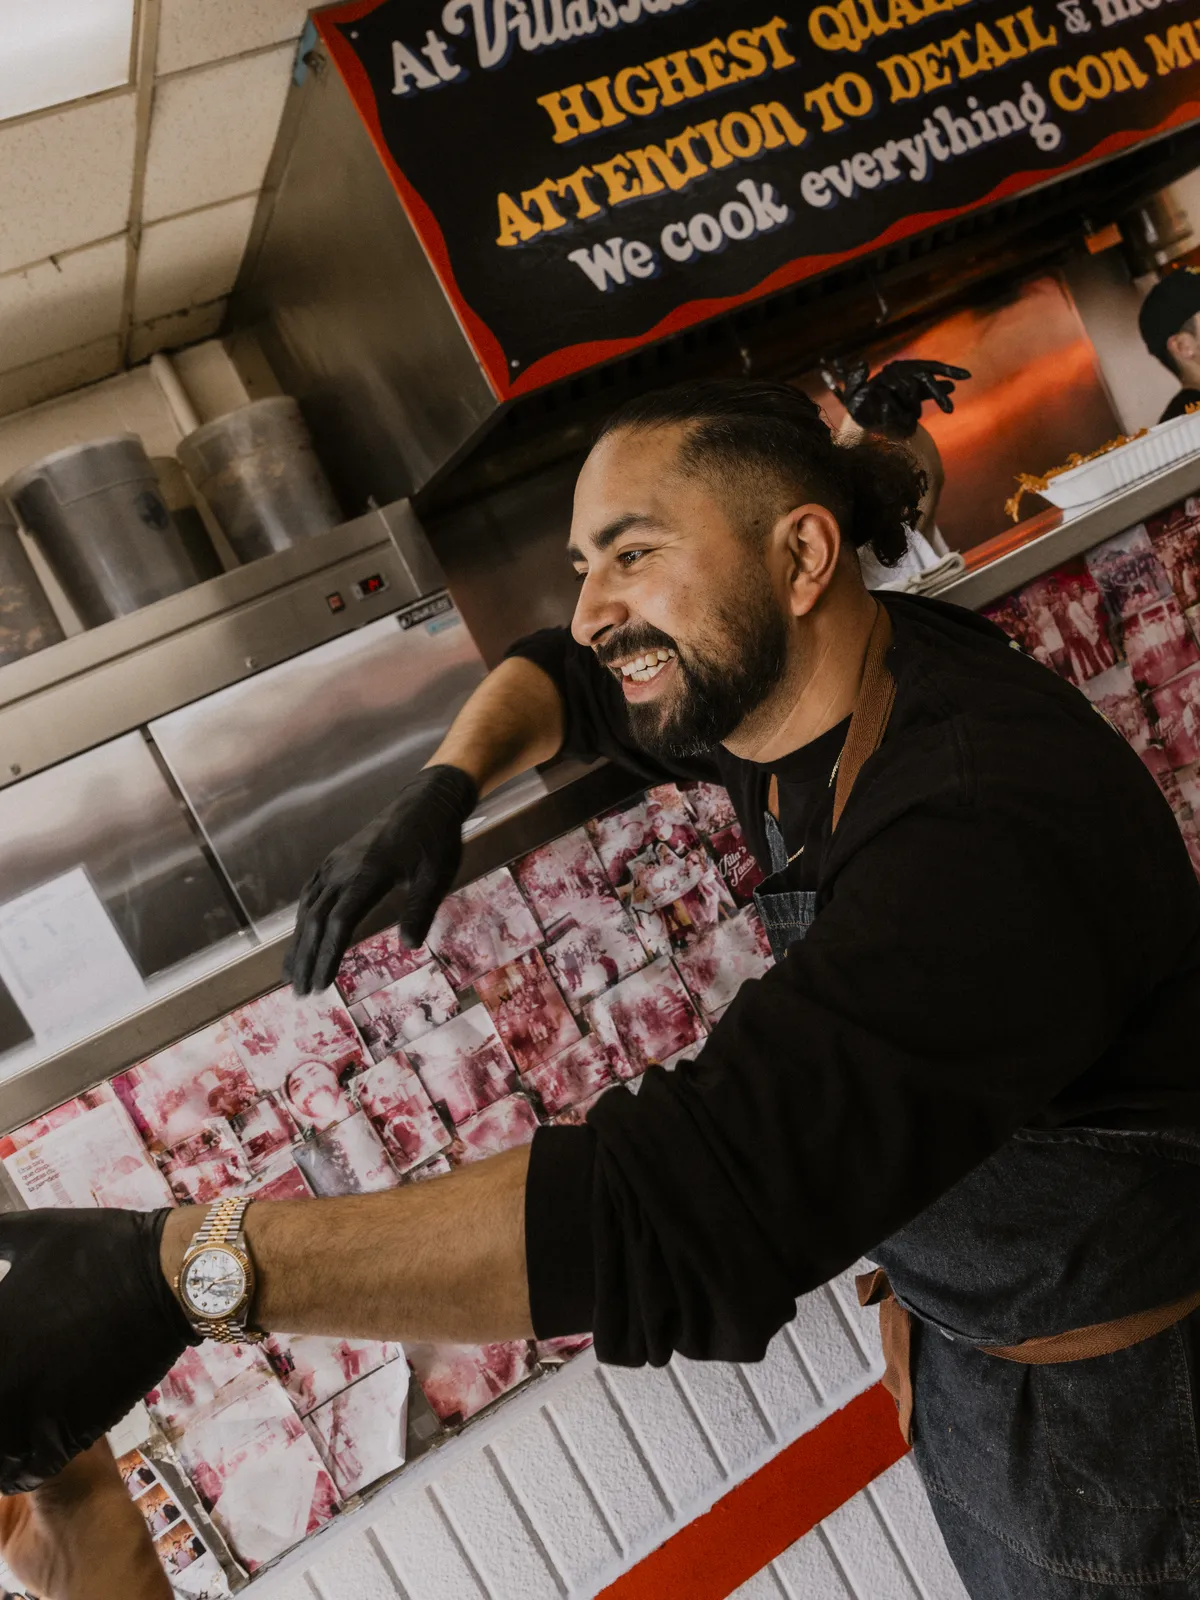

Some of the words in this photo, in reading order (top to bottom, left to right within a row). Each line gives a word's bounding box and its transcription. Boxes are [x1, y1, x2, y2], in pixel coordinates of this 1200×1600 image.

[391, 30, 461, 95] At
[496, 101, 807, 247] ATTENTION
[804, 72, 873, 132] TO
[876, 6, 1058, 103] DETAIL
[1056, 0, 1091, 34] &
[537, 16, 797, 144] HIGHEST
[567, 237, 655, 292] We
[660, 178, 789, 262] cook
[800, 81, 1062, 208] everything
